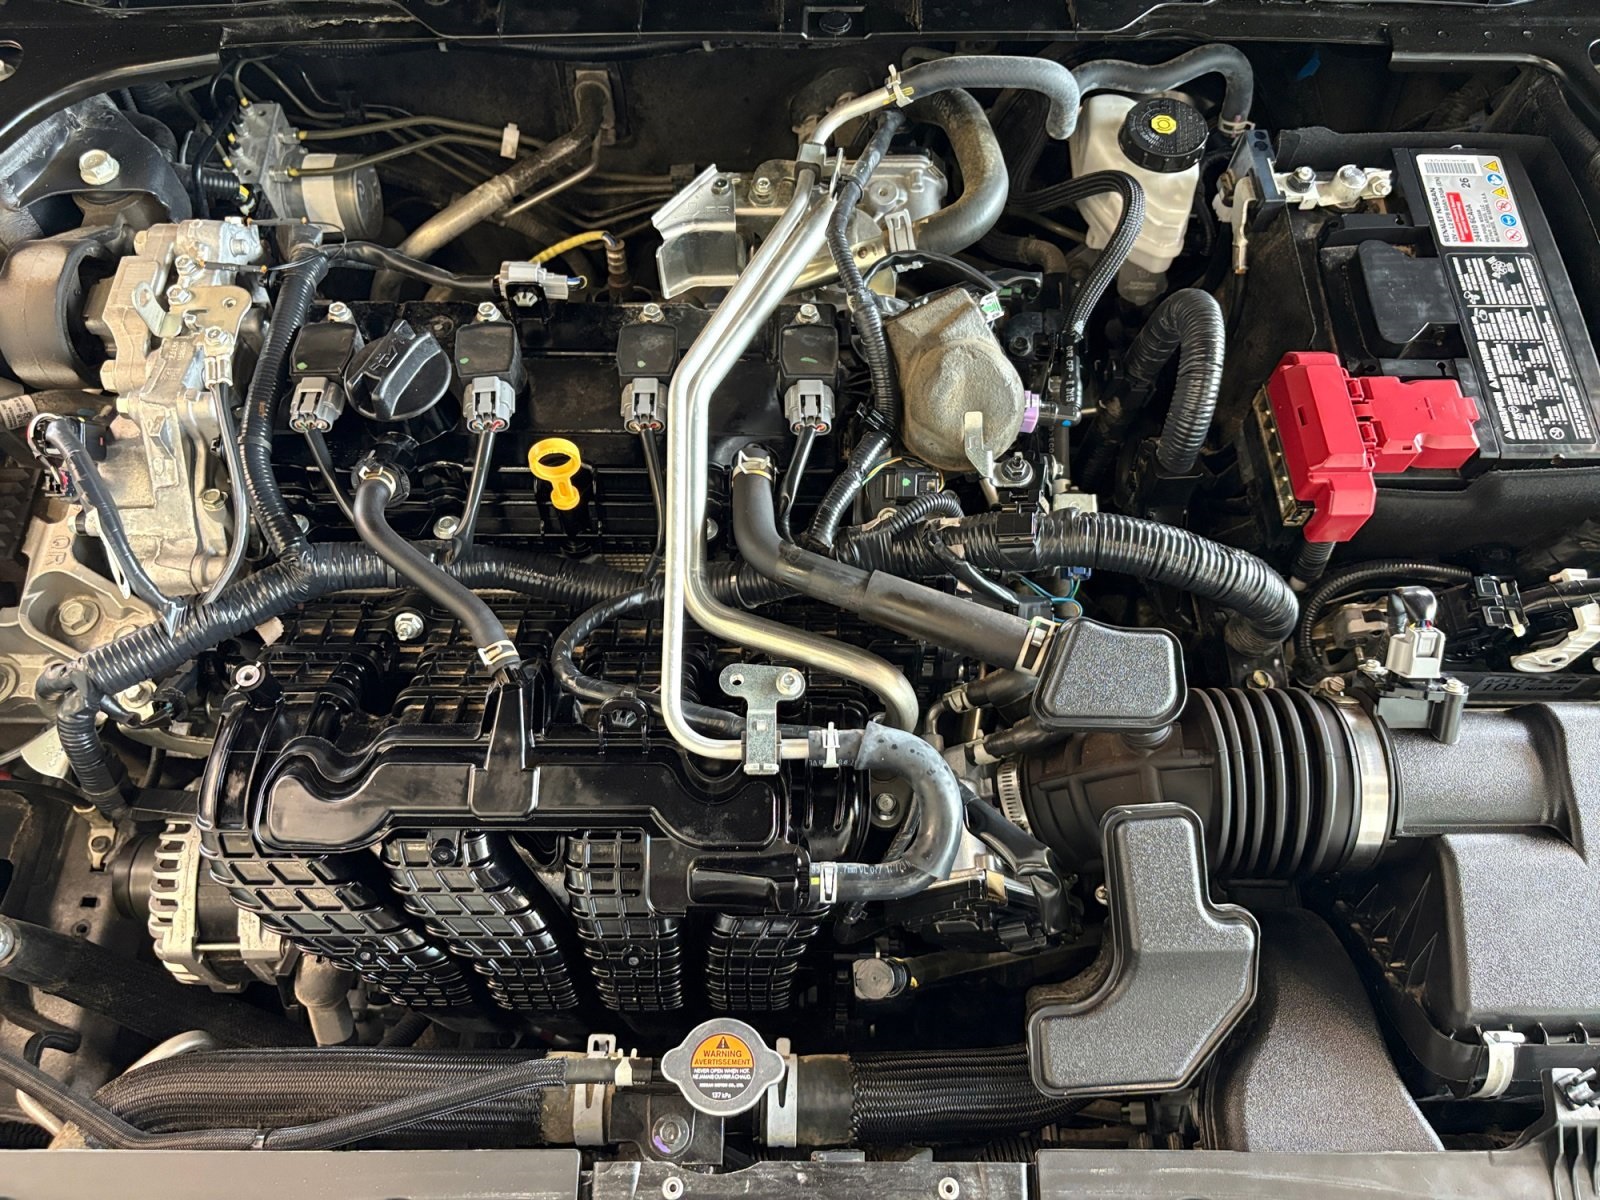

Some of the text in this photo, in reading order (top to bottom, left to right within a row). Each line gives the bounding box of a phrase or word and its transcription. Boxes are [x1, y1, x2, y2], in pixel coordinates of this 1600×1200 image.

[1458, 177, 1471, 188] 26
[1429, 187, 1450, 242] RENAULT NISSAN
[703, 1050, 742, 1058] WARNING
